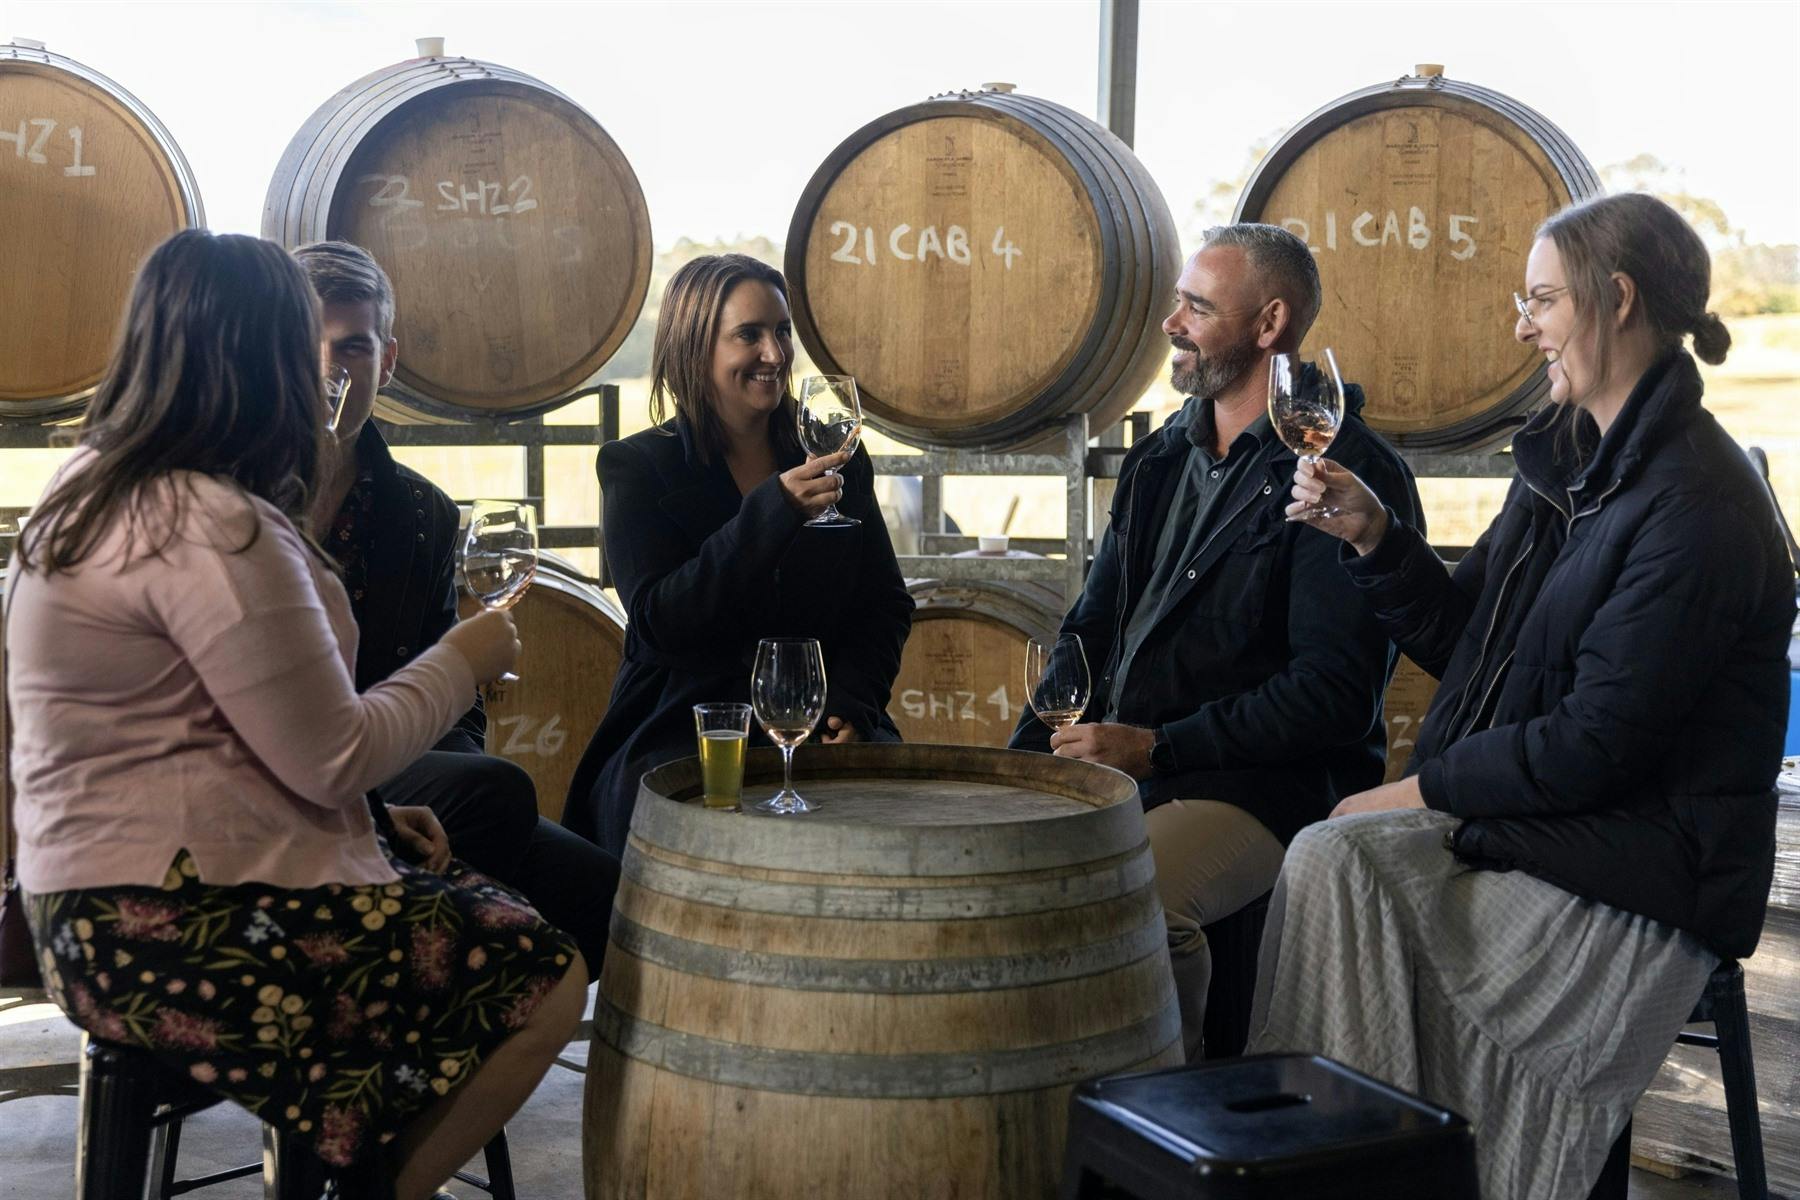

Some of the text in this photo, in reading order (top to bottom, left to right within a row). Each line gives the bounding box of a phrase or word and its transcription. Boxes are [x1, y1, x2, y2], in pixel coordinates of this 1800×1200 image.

[64, 127, 96, 177] 1
[830, 220, 1022, 271] 21 CAB 4
[1351, 206, 1432, 250] CAB
[1449, 214, 1479, 261] 5
